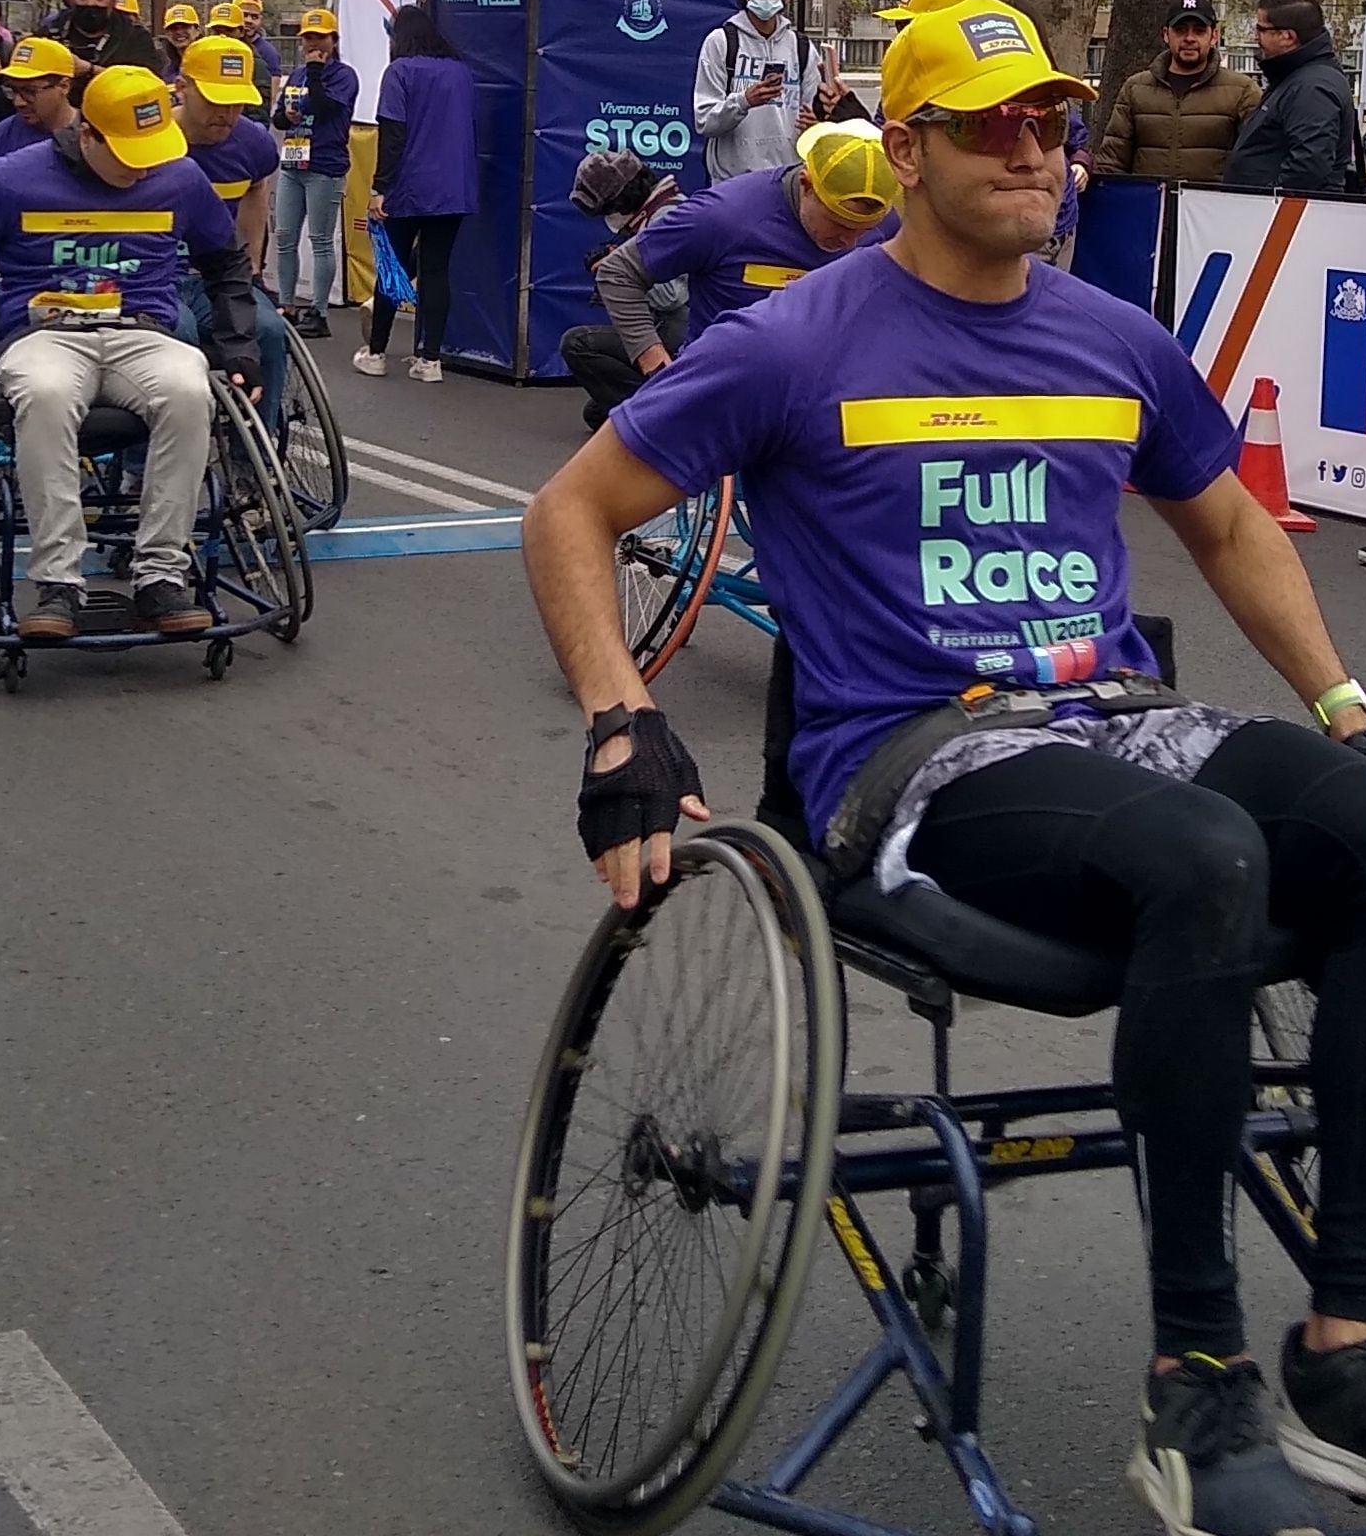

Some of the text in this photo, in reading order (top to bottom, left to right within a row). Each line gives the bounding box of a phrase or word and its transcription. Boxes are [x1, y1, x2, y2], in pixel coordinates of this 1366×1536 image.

[599, 102, 680, 116] Vivamos bien
[585, 118, 691, 157] STGO
[52, 239, 121, 268] Full
[929, 412, 987, 426] DHL
[920, 458, 1048, 528] Full
[918, 538, 1099, 606] Race
[942, 617, 1098, 648] FORTALEZA 2022
